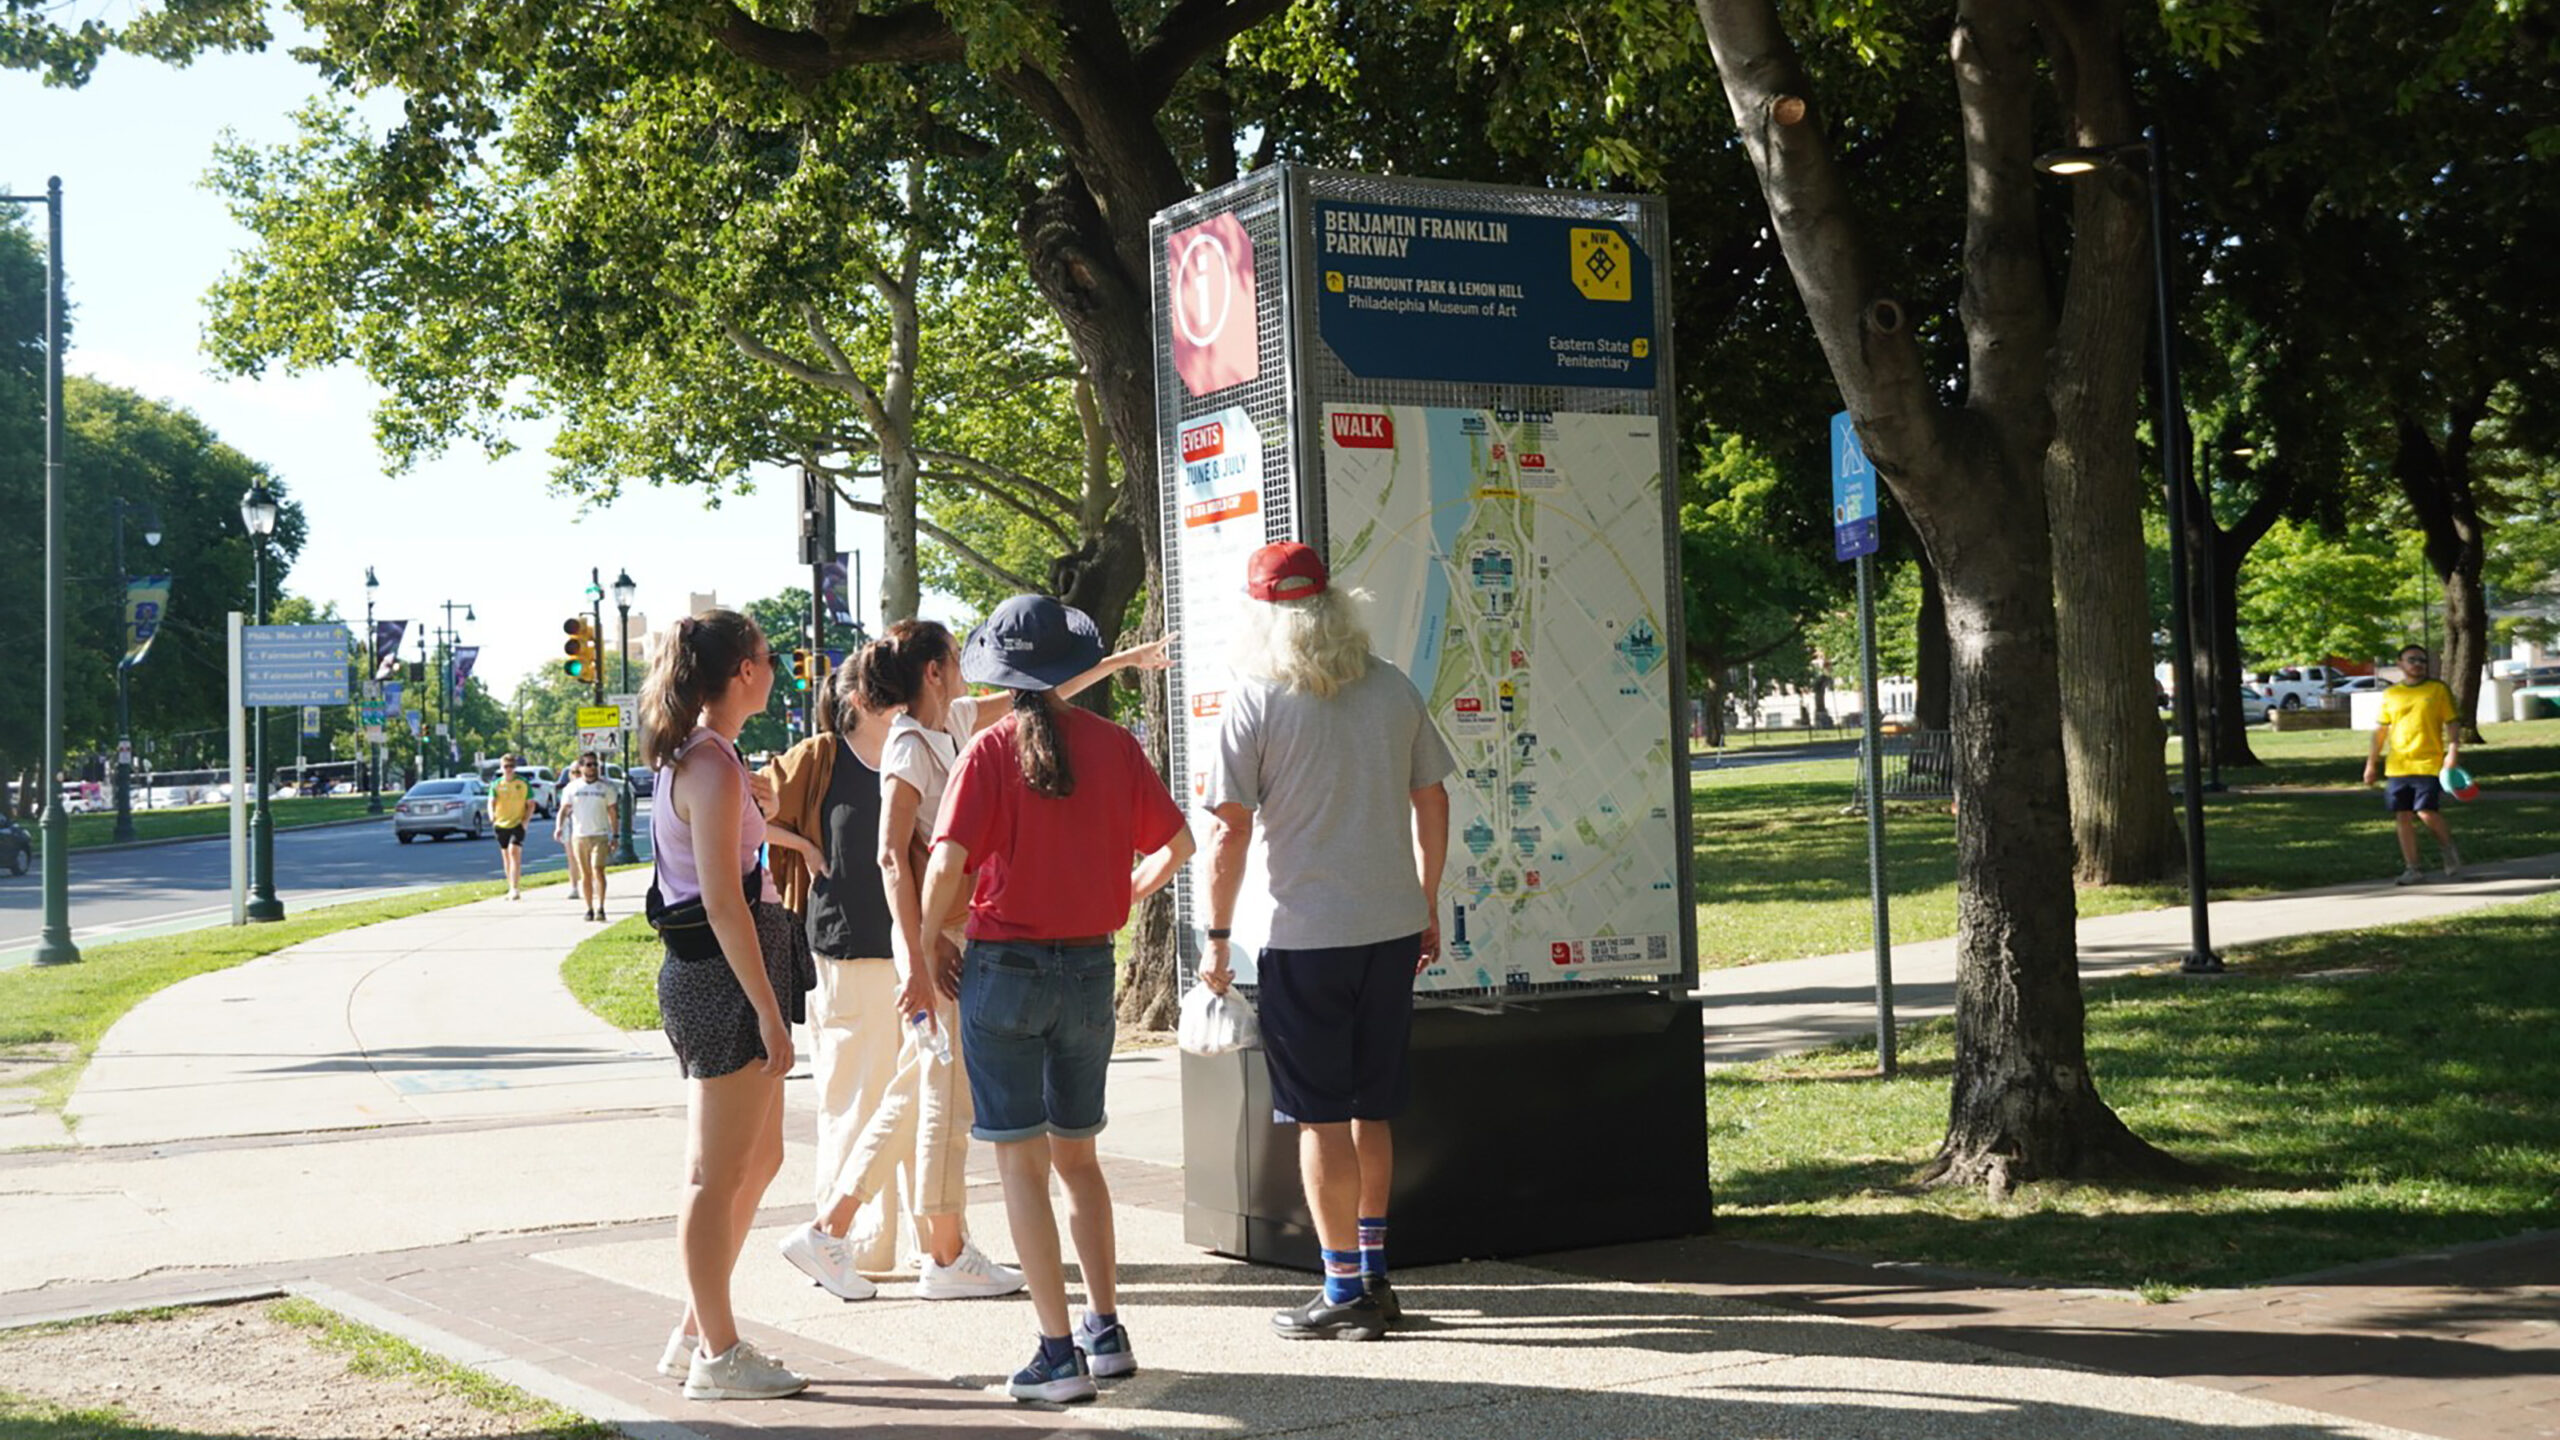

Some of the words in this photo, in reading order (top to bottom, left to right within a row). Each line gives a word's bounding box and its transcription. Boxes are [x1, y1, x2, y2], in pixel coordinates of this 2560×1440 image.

[1324, 210, 1417, 237] BENJAMIN
[1421, 218, 1508, 243] FRANKLIN
[1590, 231, 1609, 245] NW
[1325, 232, 1409, 258] PARKWAY
[1347, 274, 1413, 294] FAIRMOUNT
[1416, 279, 1446, 295] PARK
[1448, 280, 1457, 295] &
[1458, 281, 1496, 297] LEMON
[1498, 283, 1525, 299] HILL
[1348, 294, 1426, 315] Philadelphia
[1428, 298, 1479, 316] Museum
[1482, 301, 1495, 316] of
[1497, 301, 1518, 317] Art
[1549, 336, 1595, 352] Eastern
[1598, 338, 1630, 353] State
[1557, 354, 1630, 372] Penitentiary
[1334, 415, 1384, 438] WALK
[1183, 424, 1221, 453] EVENTS
[1185, 461, 1211, 486] JUNE
[1222, 453, 1247, 478] JULY
[260, 650, 311, 660] Fairmount
[263, 670, 313, 680] Fairmount
[248, 691, 308, 701] Philadelphia
[311, 691, 329, 699] Zoo
